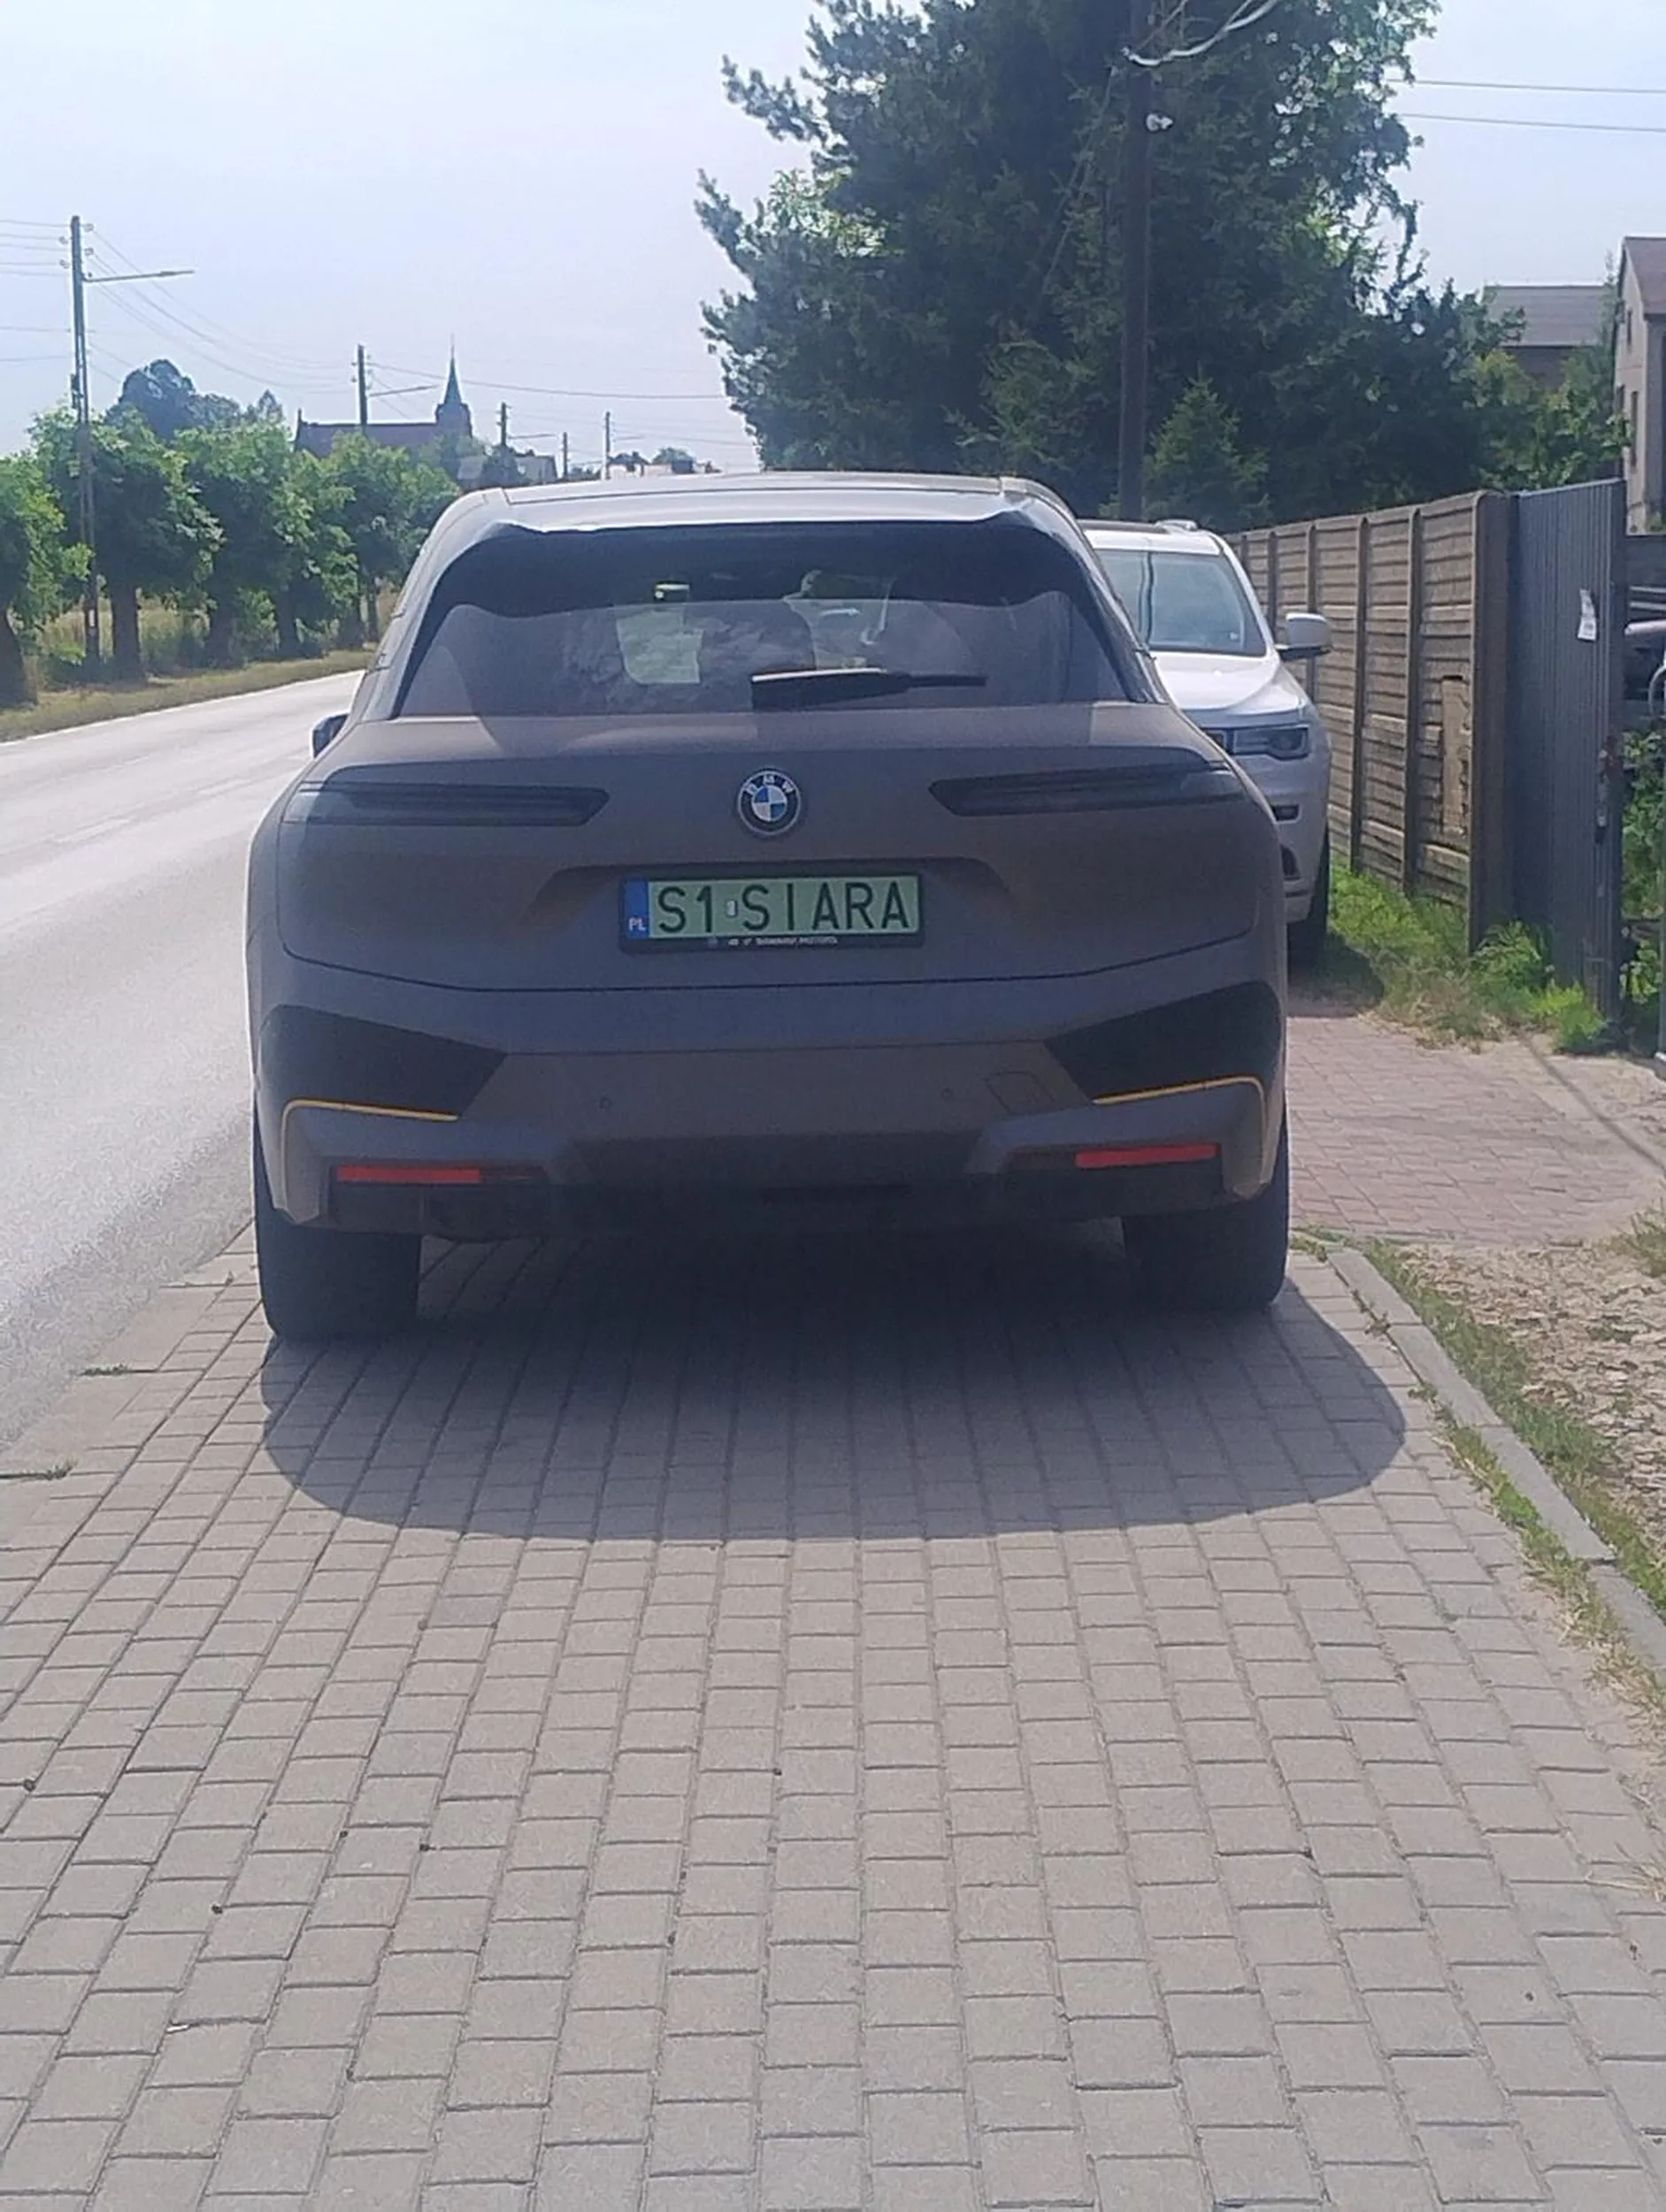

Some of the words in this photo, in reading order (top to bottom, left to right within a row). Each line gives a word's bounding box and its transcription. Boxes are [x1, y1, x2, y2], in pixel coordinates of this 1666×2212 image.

[742, 773, 795, 795] BMW
[657, 886, 712, 933] S1
[741, 881, 910, 931] SIARA
[628, 918, 646, 931] PL
